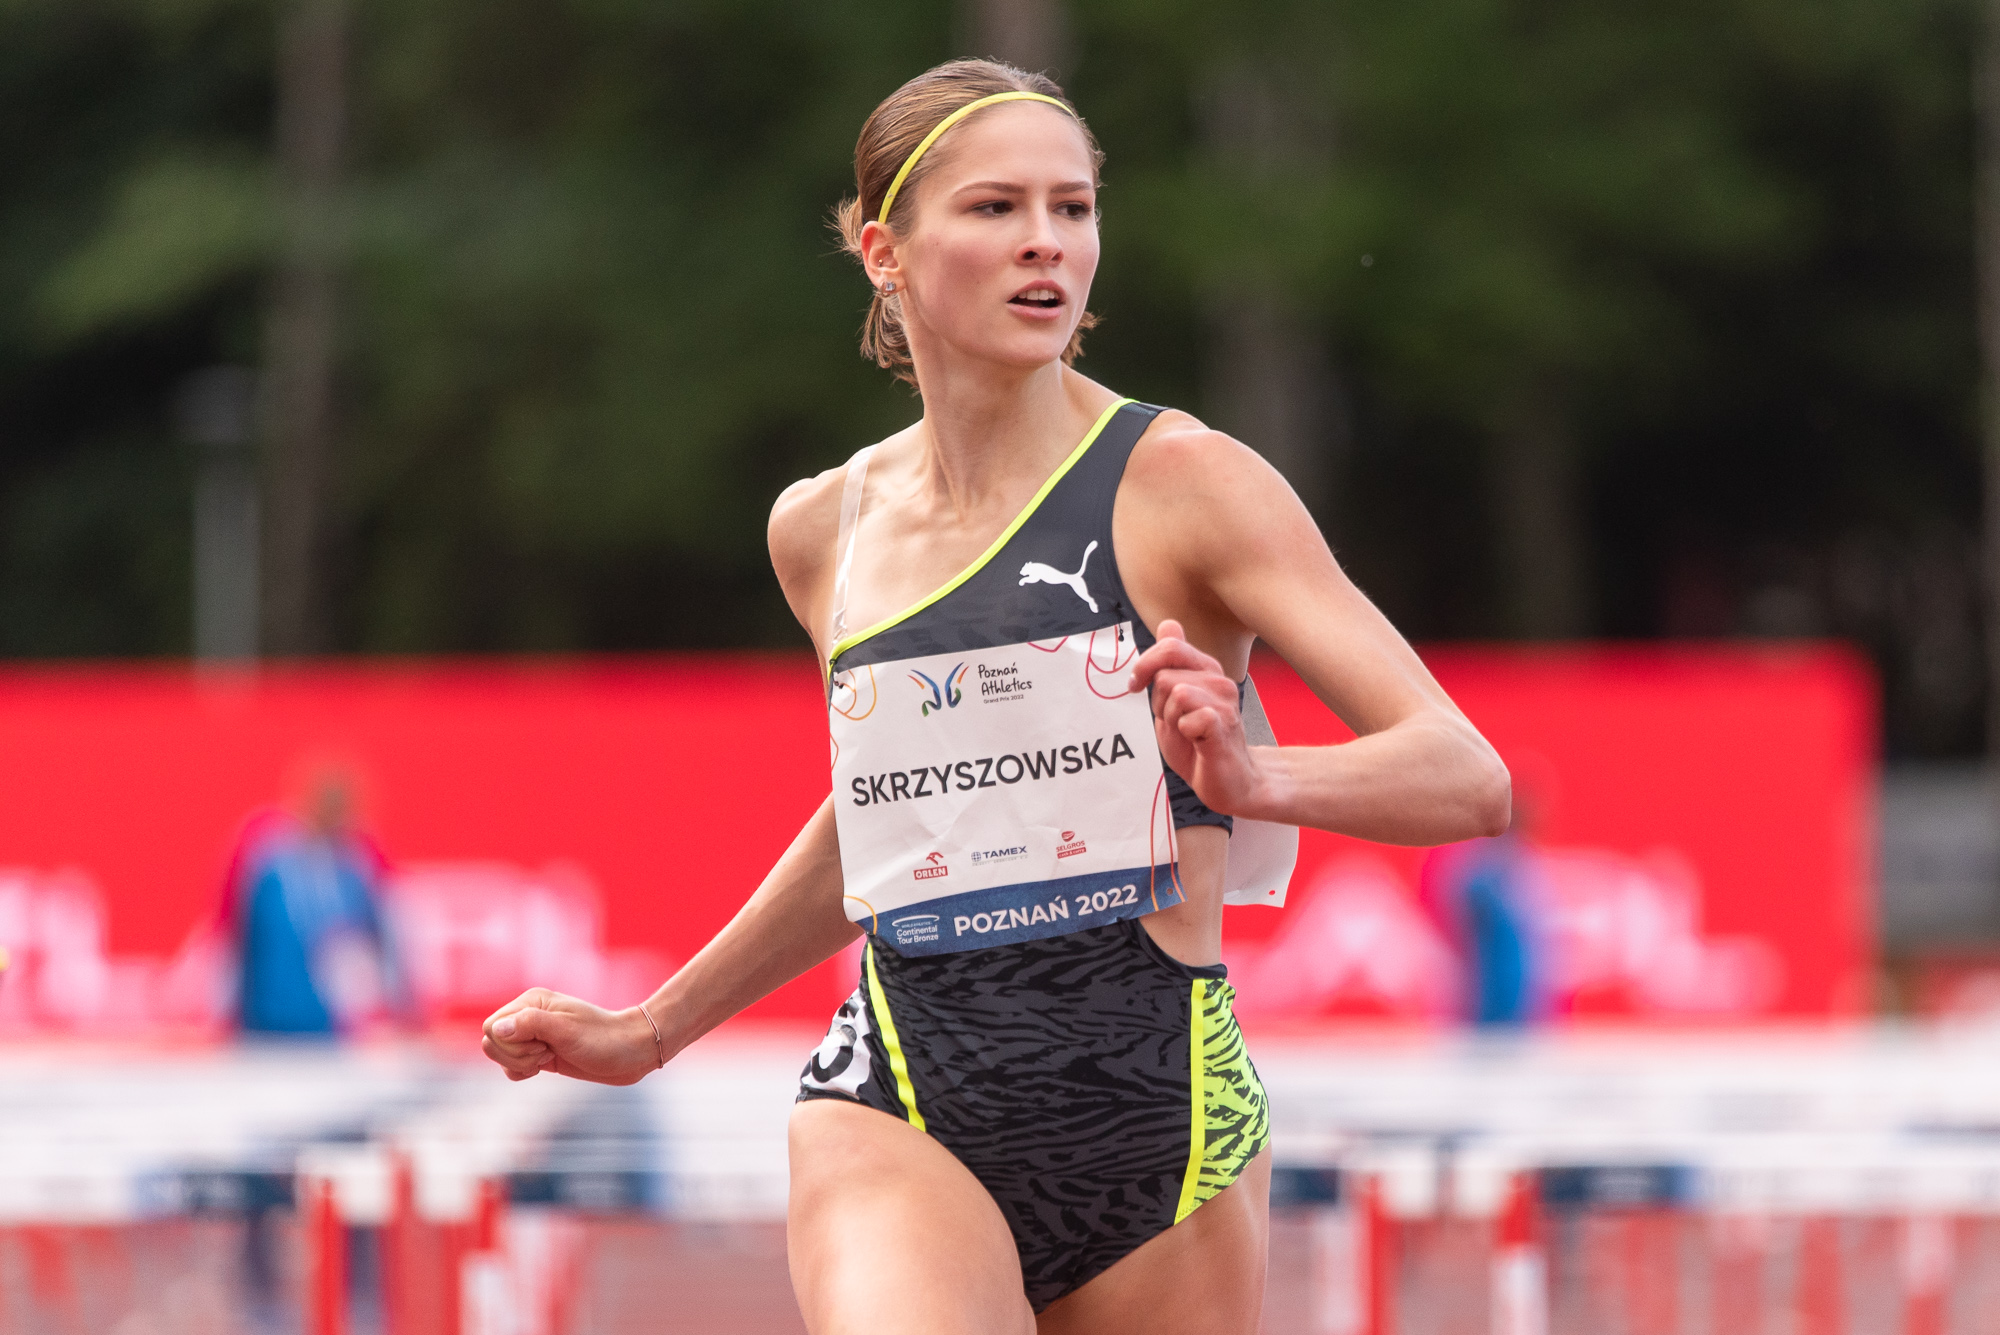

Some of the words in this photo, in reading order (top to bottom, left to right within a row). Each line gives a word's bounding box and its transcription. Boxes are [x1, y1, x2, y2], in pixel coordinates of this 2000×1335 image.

[978, 662, 1018, 679] Poznań
[981, 678, 1033, 696] Athletics
[851, 733, 1136, 807] SKRZYSZOWSKA
[982, 845, 1027, 859] TAMEX
[1056, 840, 1085, 852] SELGROS
[915, 867, 946, 879] ORLEN
[953, 895, 1070, 937] POZNAŃ
[1075, 884, 1139, 916] 2022
[896, 925, 938, 937] Continental
[897, 937, 913, 945] Tour
[913, 934, 939, 943] Bronze
